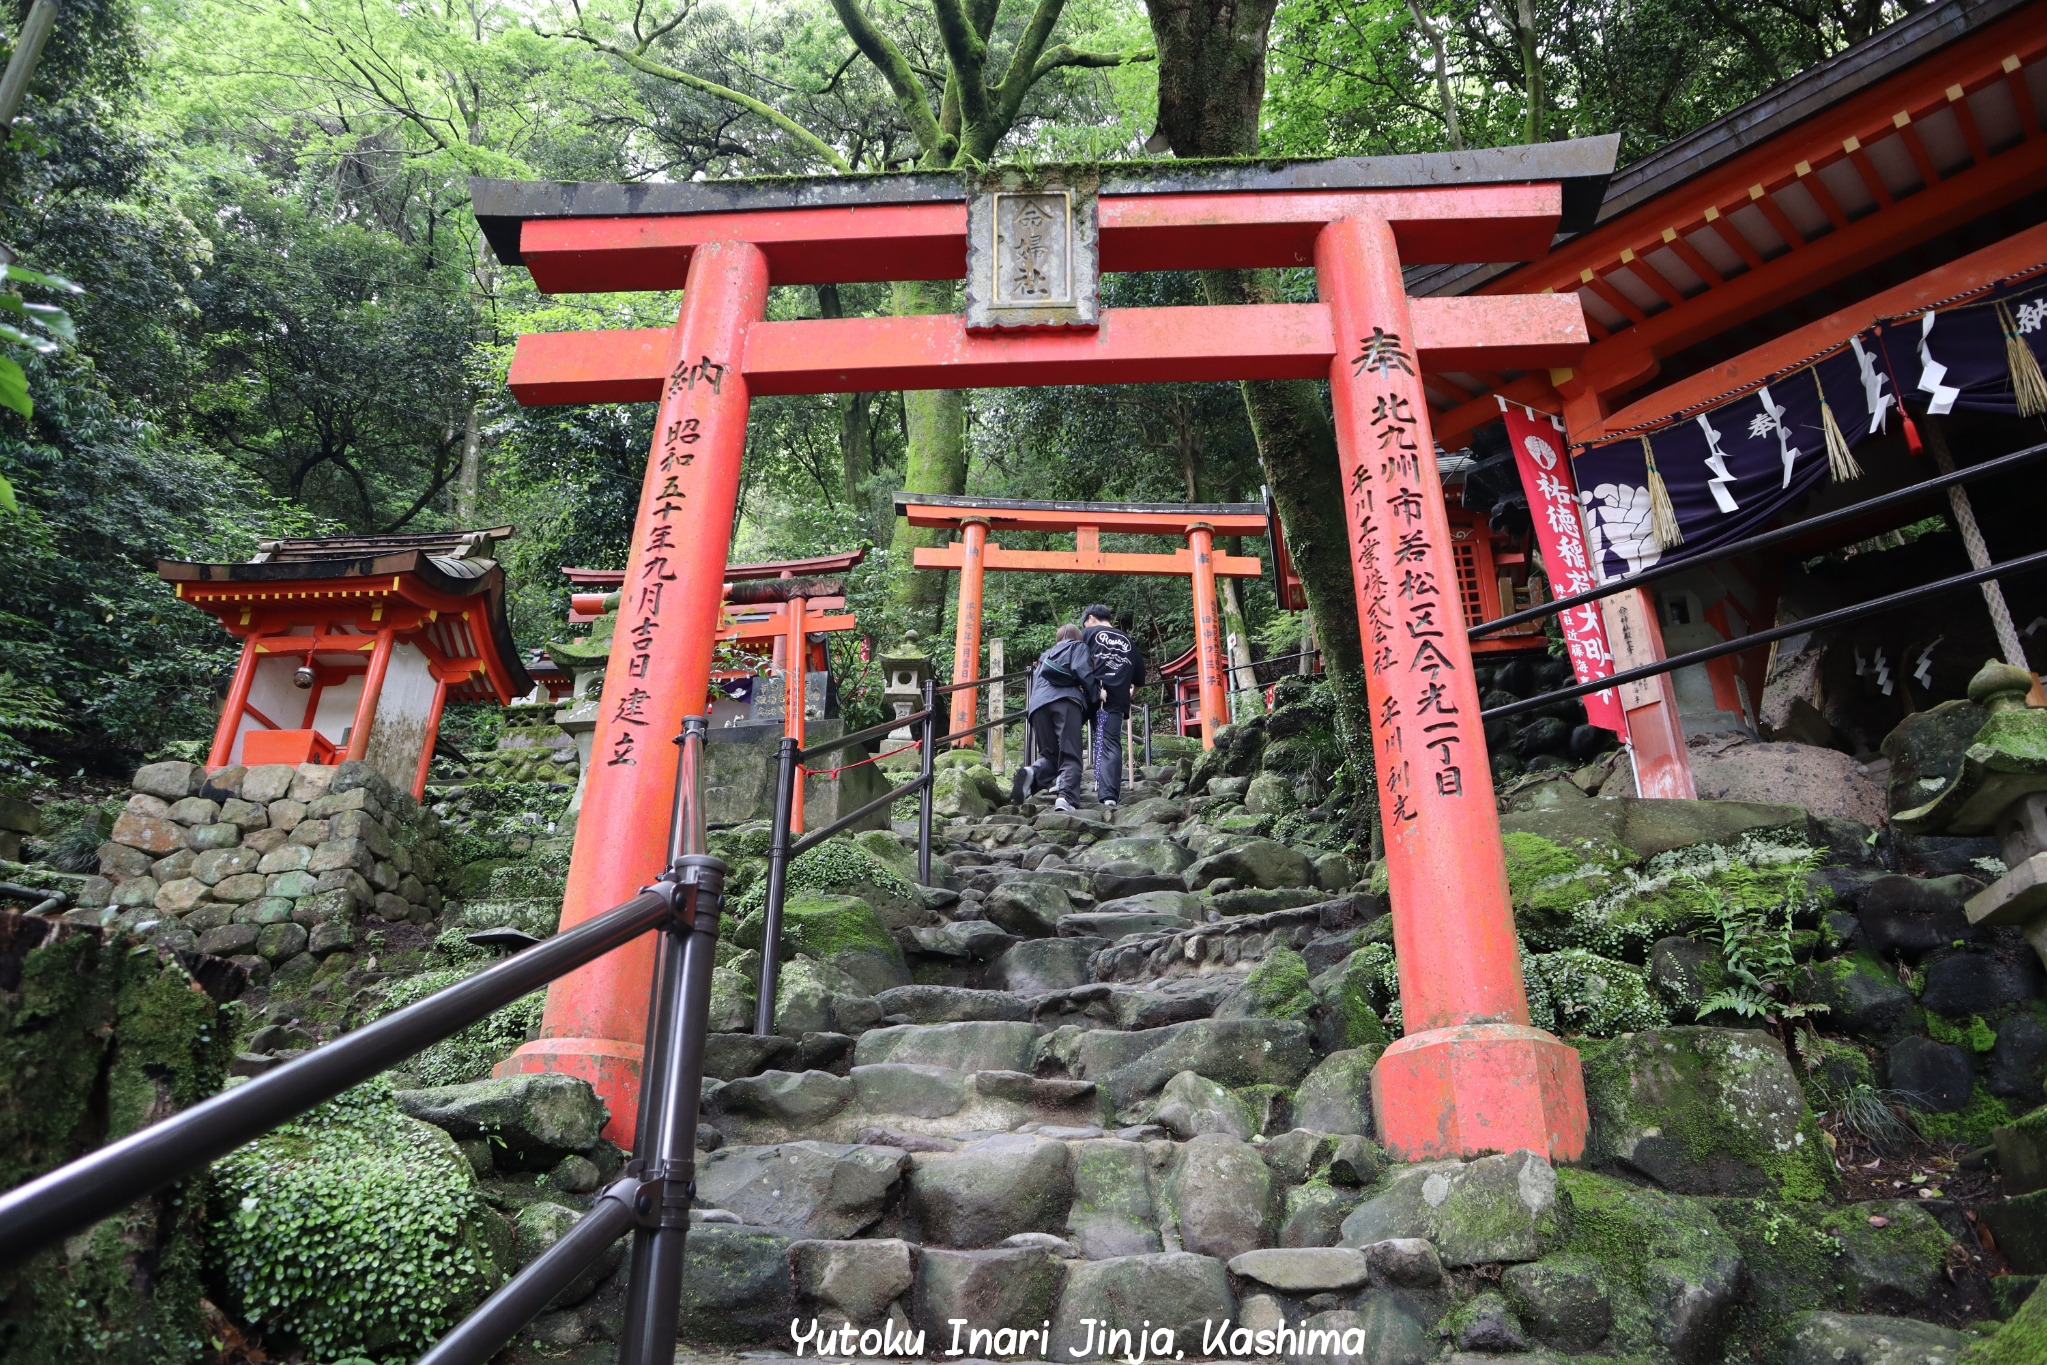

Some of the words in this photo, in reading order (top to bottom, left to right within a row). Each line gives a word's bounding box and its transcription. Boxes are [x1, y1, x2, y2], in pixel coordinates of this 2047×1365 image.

[668, 356, 723, 400] 納
[1351, 326, 1415, 380] 奉
[1748, 413, 1777, 440] 奉
[2016, 298, 2047, 333] 納
[1370, 393, 1463, 797] 北九州市若松区今光一丁目
